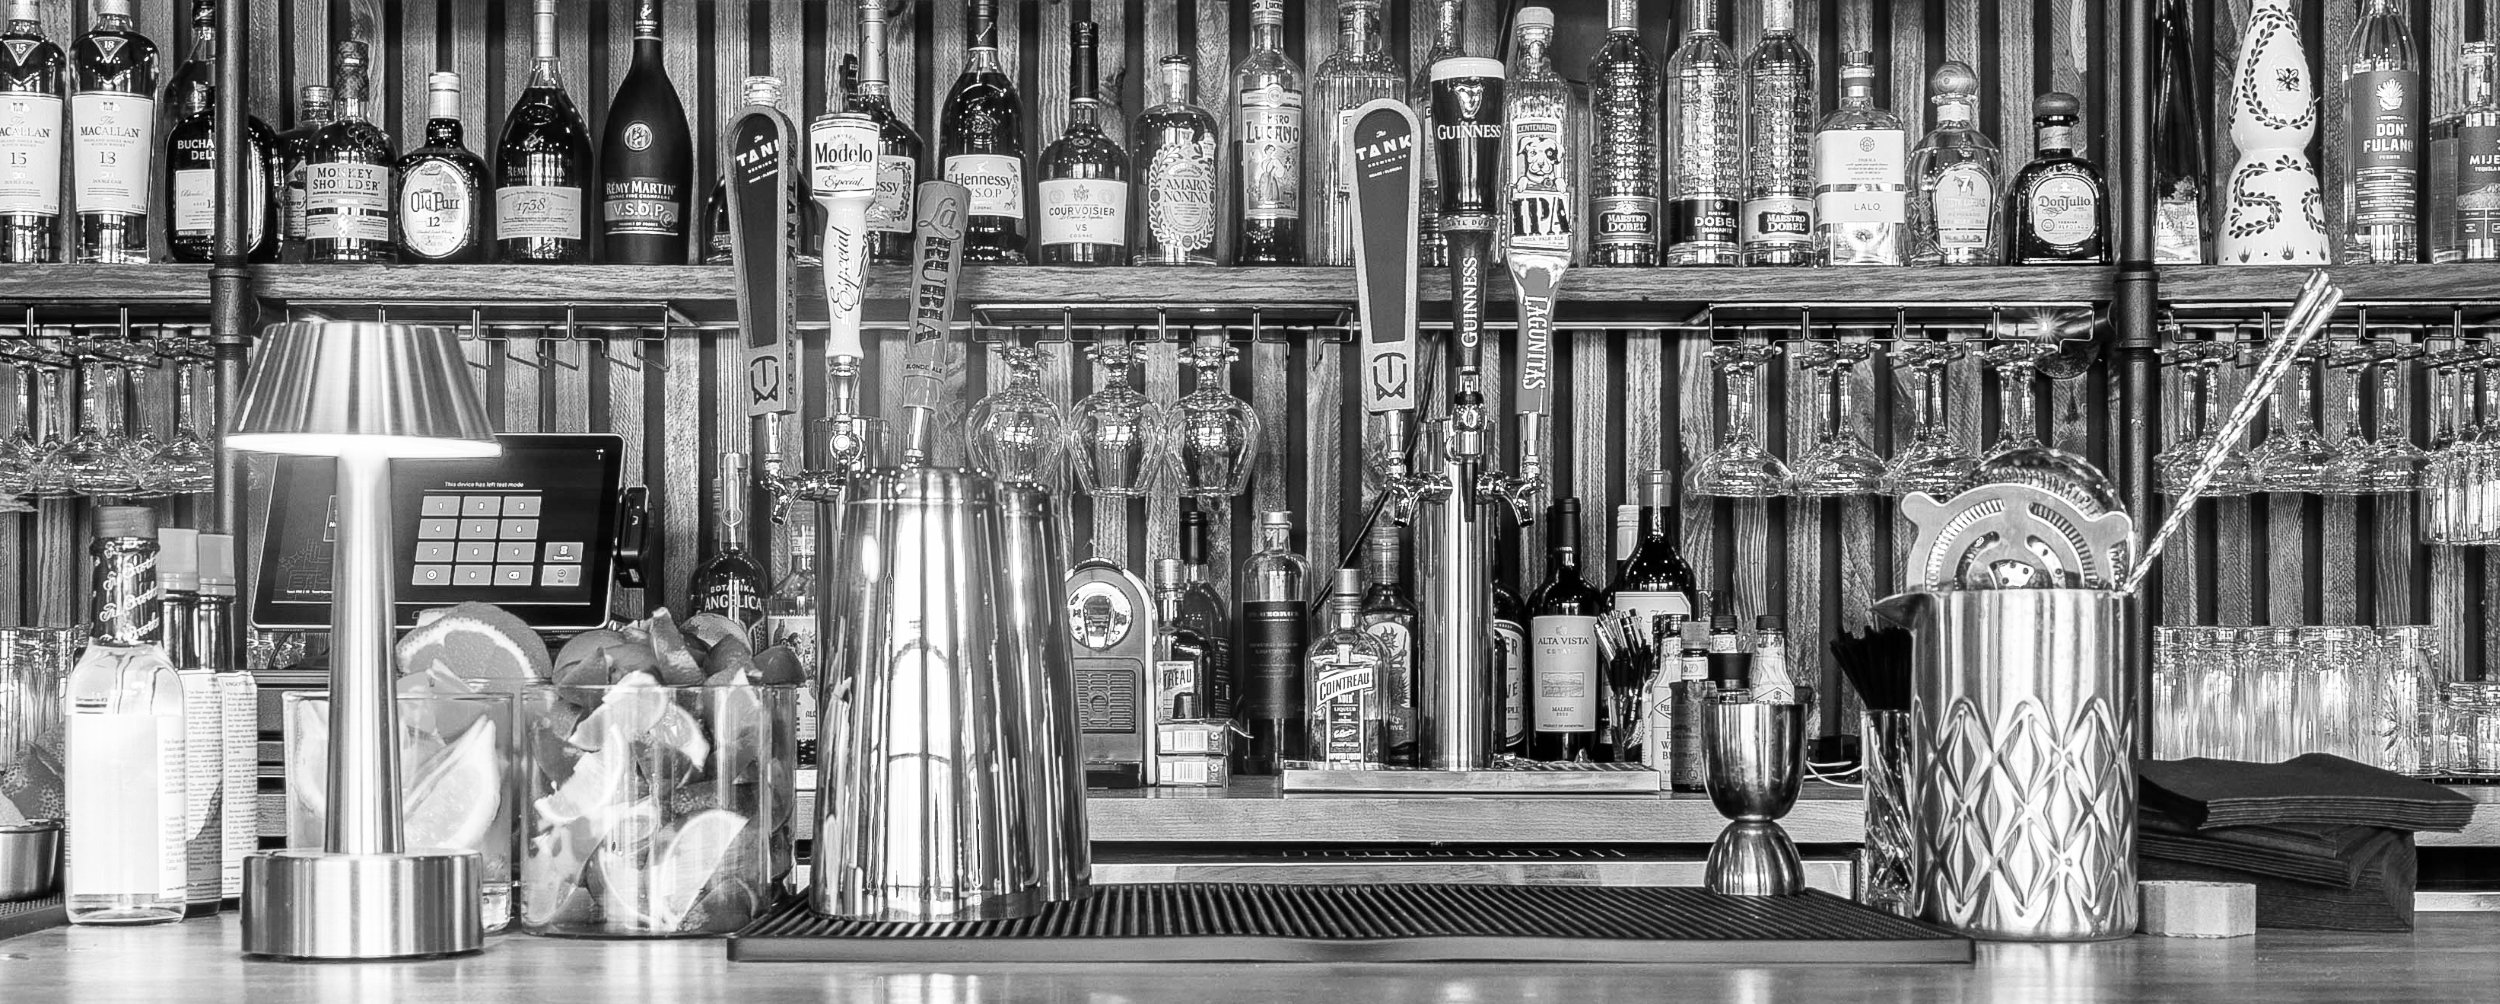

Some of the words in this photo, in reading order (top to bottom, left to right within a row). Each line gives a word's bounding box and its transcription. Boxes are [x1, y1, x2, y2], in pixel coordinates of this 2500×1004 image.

[15, 43, 26, 51] 15
[104, 40, 115, 49] 18
[0, 127, 50, 138] ACALLAN
[80, 126, 141, 138] MACALLAN
[1437, 124, 1502, 140] GUINNESS
[2376, 123, 2405, 137] DON
[177, 139, 215, 149] BUCHA
[1355, 134, 1412, 160] TANK
[11, 152, 27, 165] 15
[815, 142, 873, 164] Modelo
[2469, 154, 2500, 165] MIJE
[317, 167, 373, 179] MONKEY
[312, 179, 379, 191] SHOULDER
[954, 172, 1013, 189] Hennessy
[1164, 178, 1208, 192] AMARO
[631, 180, 674, 195] MARTIN
[970, 187, 1002, 198] .S.O.P
[411, 192, 434, 212] Old
[516, 197, 546, 215] 1738
[1854, 202, 1881, 211] LALO
[1048, 206, 1115, 216] COURVOISIER
[1511, 196, 1570, 236] IPA
[426, 216, 440, 228] 12
[786, 181, 797, 261] TANK
[917, 197, 962, 242] La
[1694, 216, 1737, 228] DOBEL
[1766, 214, 1806, 223] MAESTRO
[1075, 223, 1088, 232] VS
[1608, 222, 1647, 231] DOBEL
[1767, 222, 1806, 232] DOBEL
[830, 225, 859, 319] Especial
[914, 236, 952, 344] RUBIA
[1461, 257, 1479, 348] GUINNESS
[1523, 296, 1551, 390] LAGUNITAS
[1537, 637, 1558, 645] ALTA
[1561, 637, 1589, 645] VISTA
[1163, 667, 1192, 692] TREAU
[1320, 672, 1370, 701] COINTREAU
